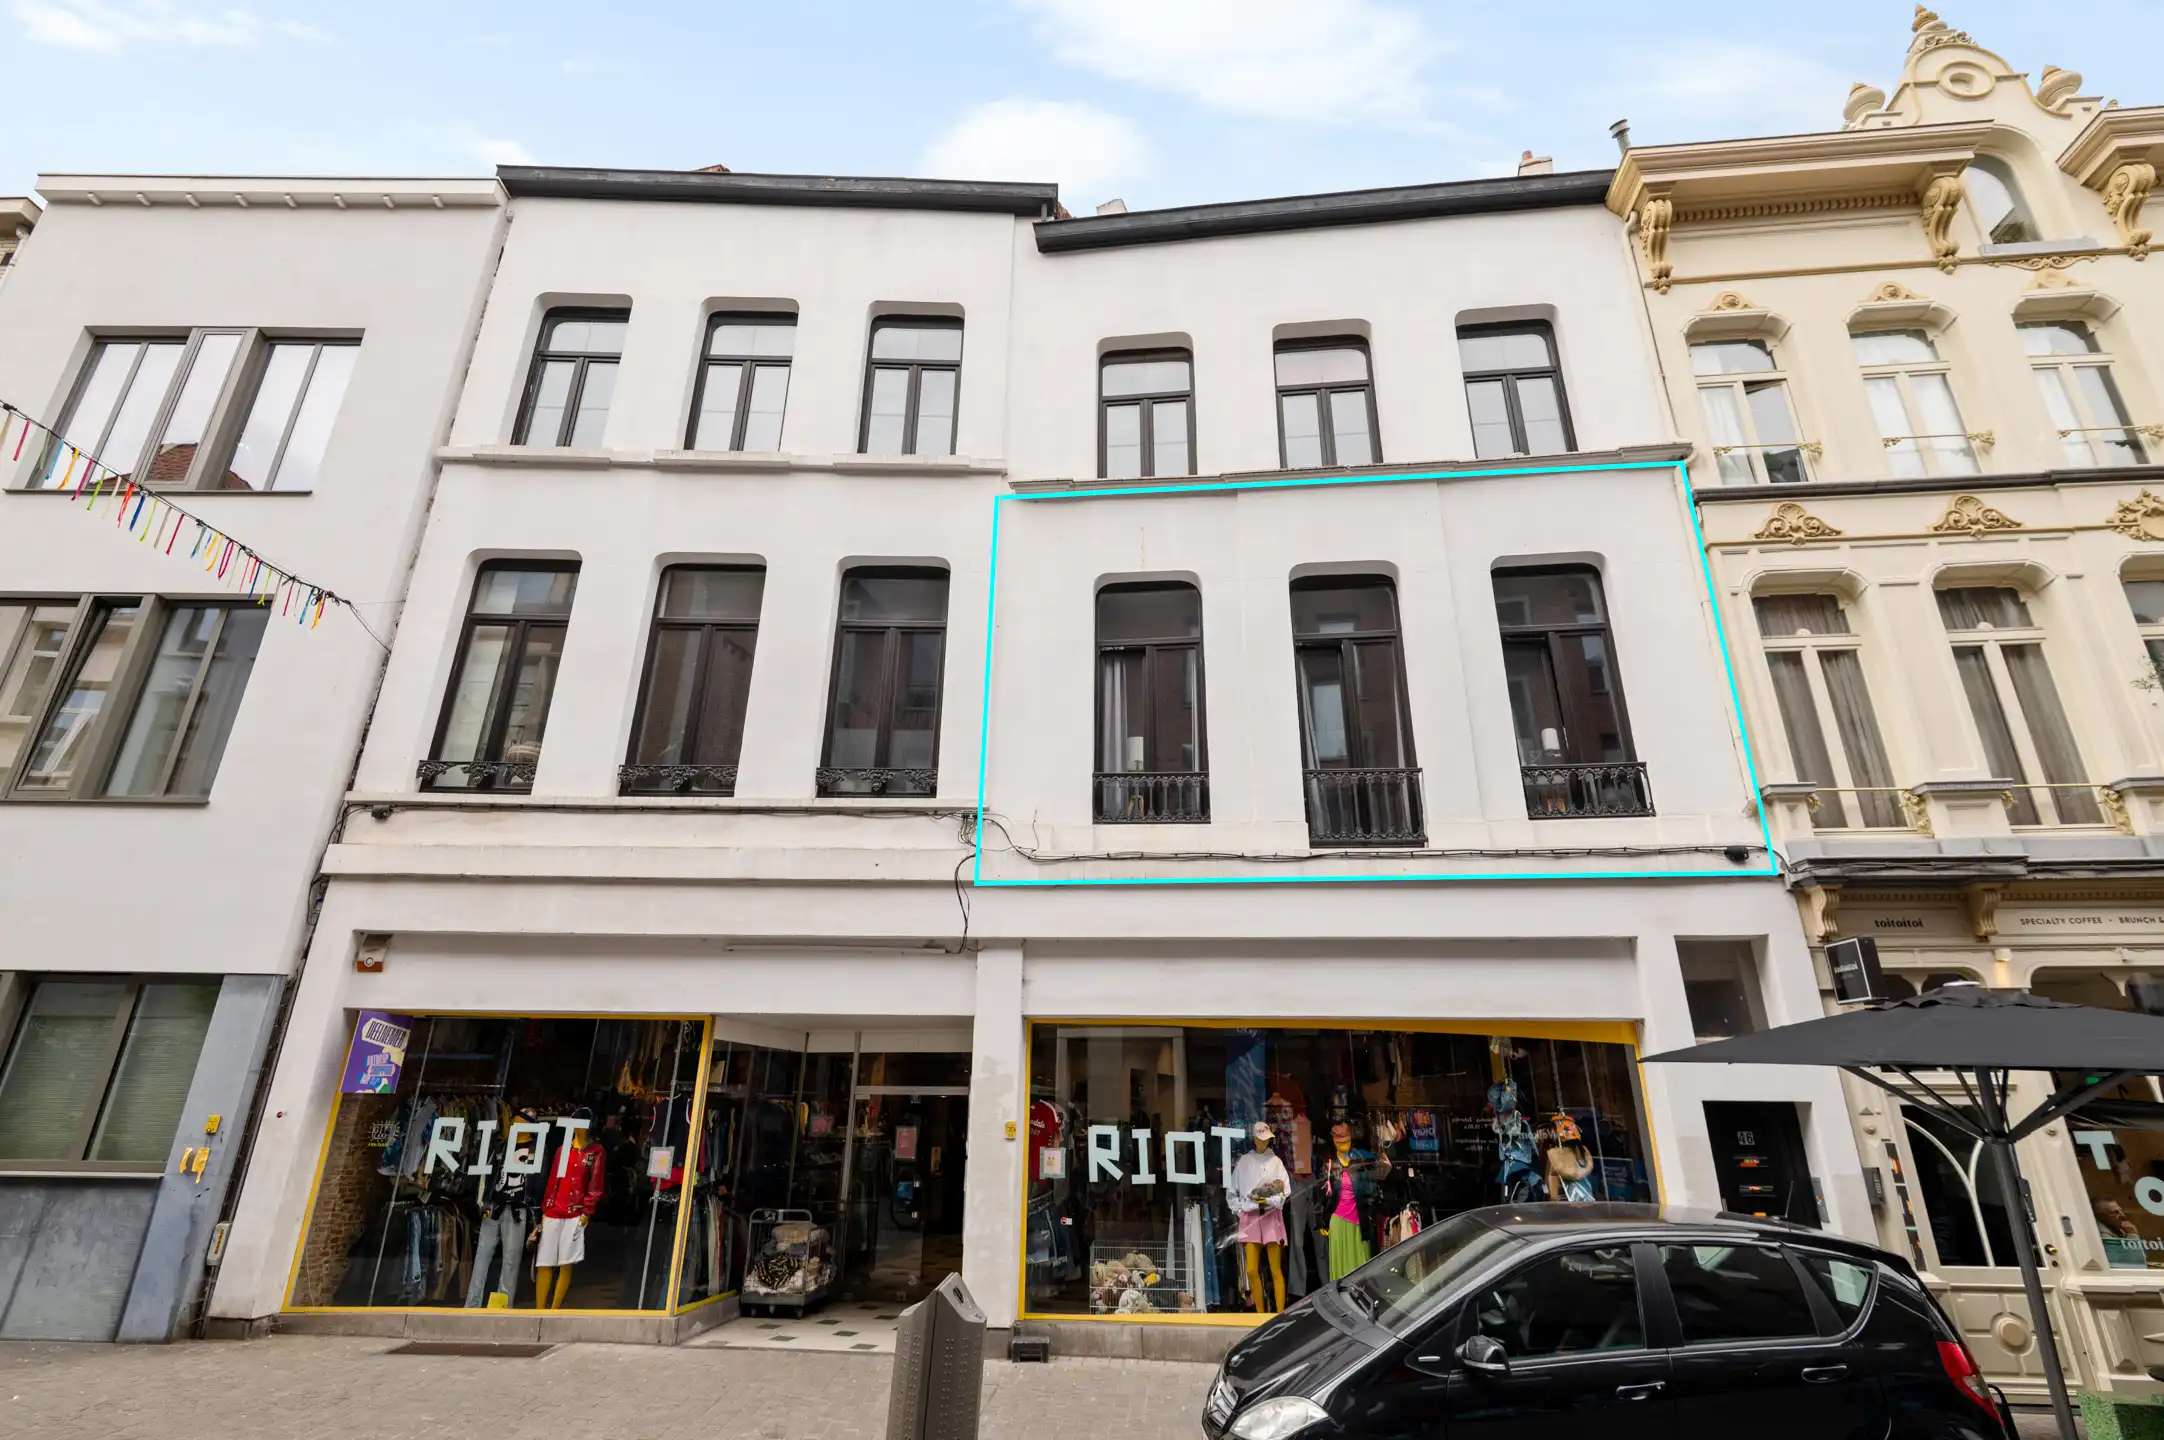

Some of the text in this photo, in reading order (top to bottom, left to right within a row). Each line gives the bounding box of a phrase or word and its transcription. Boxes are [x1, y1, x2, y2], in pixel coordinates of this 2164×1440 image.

[1874, 916, 1924, 928] toitoitoi
[2020, 918, 2066, 926] SPECIALTY
[2069, 917, 2103, 925] COFFEE
[2118, 916, 2156, 924] BRUNCH
[1739, 1132, 1754, 1145] 46
[424, 1117, 591, 1178] RIOT
[1088, 1125, 1245, 1188] RIOT
